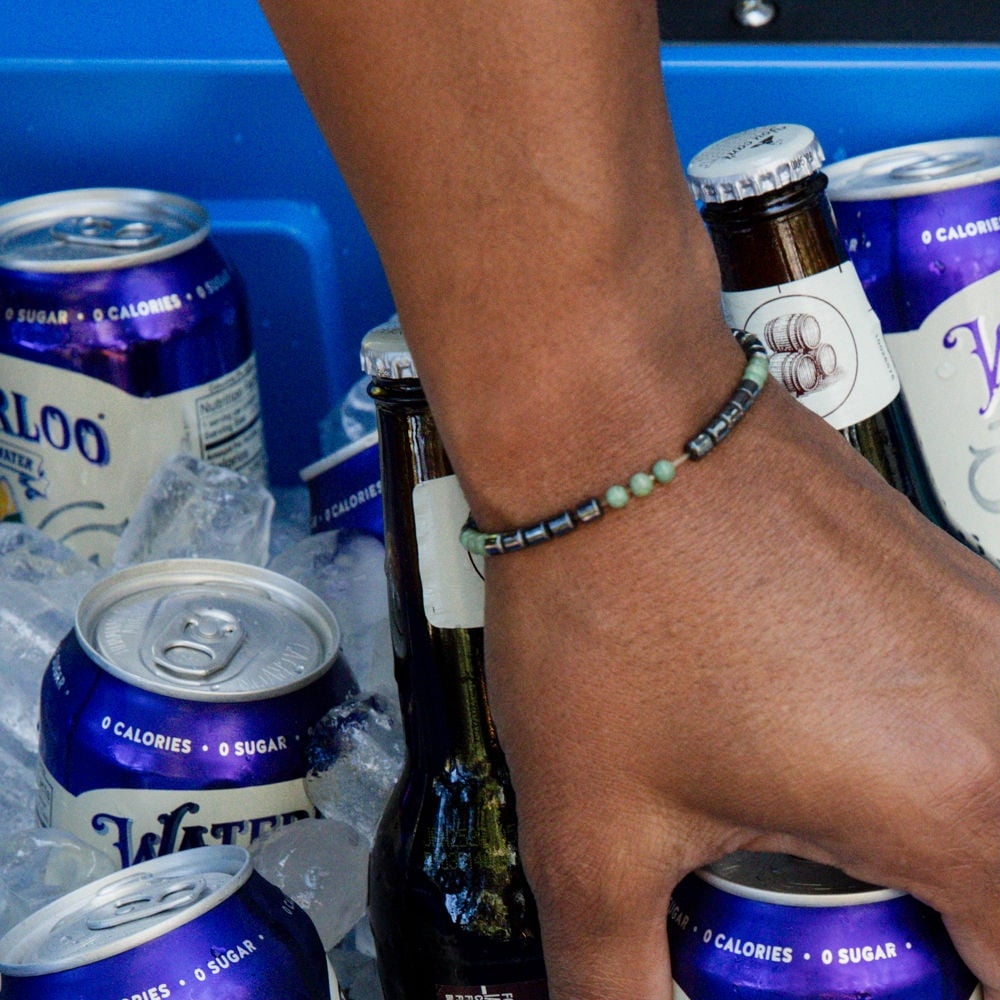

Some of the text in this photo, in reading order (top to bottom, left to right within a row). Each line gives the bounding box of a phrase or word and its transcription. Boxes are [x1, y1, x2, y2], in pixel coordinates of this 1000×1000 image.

[17, 293, 183, 325] SUGAR 0 CALORIES
[331, 480, 383, 519] CALORIES
[101, 716, 288, 757] 0 CALORIES 0 SUGAR
[194, 968, 206, 982] 0
[207, 939, 258, 975] SUGAR
[703, 928, 897, 965] 0 CALORIES 0 SUGAR
